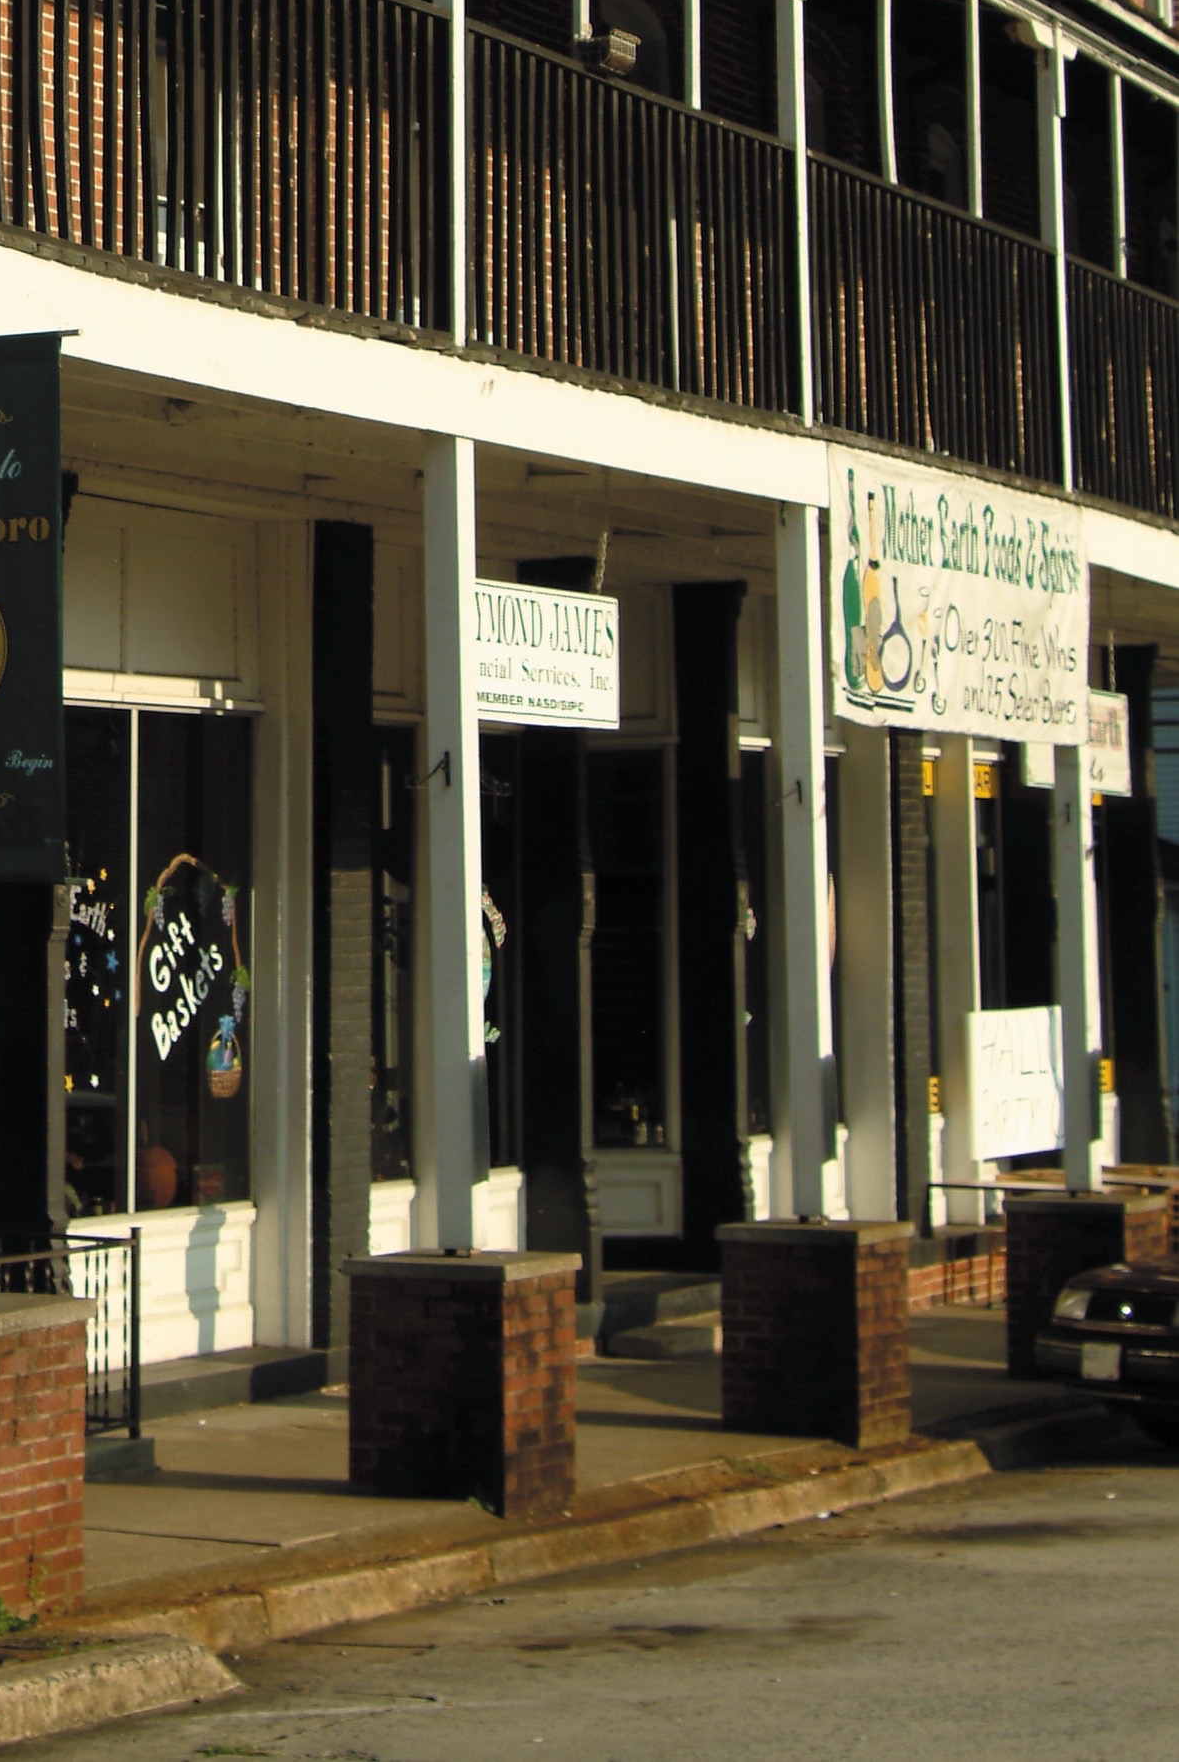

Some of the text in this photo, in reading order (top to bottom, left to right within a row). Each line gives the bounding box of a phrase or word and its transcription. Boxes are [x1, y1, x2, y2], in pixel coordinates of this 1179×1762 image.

[882, 484, 933, 567] Mother
[937, 494, 979, 575] Earth
[983, 504, 1021, 586] Foods
[549, 602, 615, 659] JAMES
[945, 603, 980, 656] Over
[1012, 620, 1041, 669] Fine
[476, 691, 524, 707] MEMBER
[589, 666, 613, 691] Inc.
[5, 749, 53, 776] Begin
[69, 884, 108, 938] Earth
[149, 911, 195, 992] Gift
[151, 943, 223, 1061] Baskets
